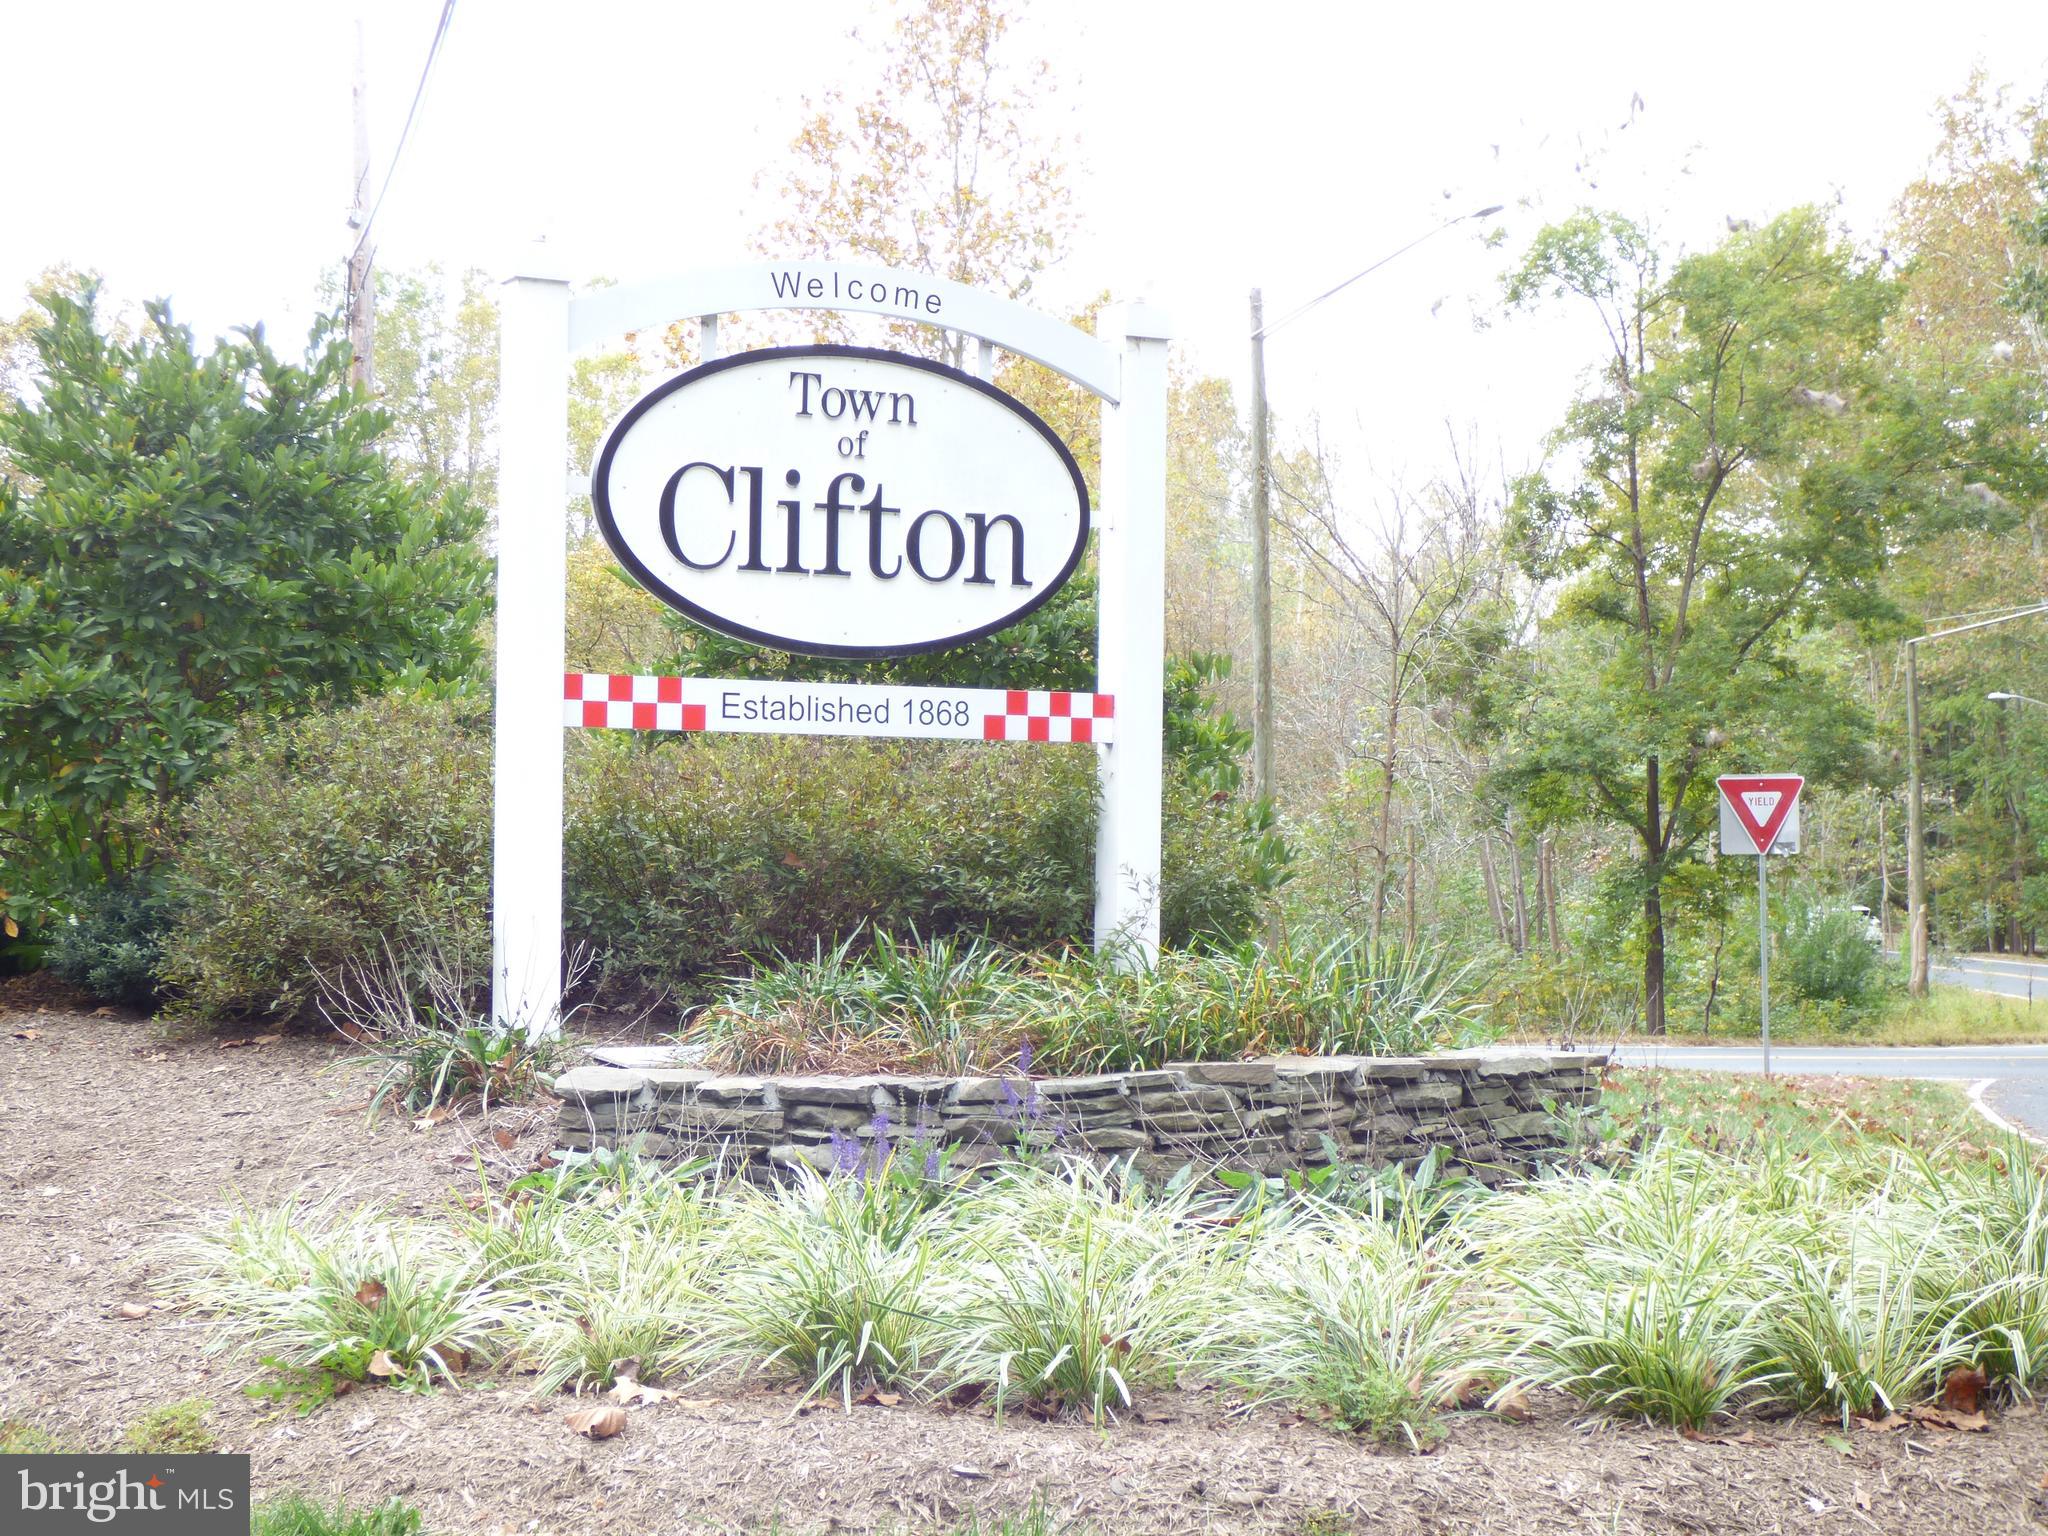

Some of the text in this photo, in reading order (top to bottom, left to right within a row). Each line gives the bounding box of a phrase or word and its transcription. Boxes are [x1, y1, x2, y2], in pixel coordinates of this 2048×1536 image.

[771, 271, 943, 315] Welcome
[789, 371, 917, 426] Town
[837, 430, 870, 459] of
[658, 461, 1034, 590] Clifton
[721, 691, 970, 726] Established 1868
[1748, 796, 1775, 807] YIELD
